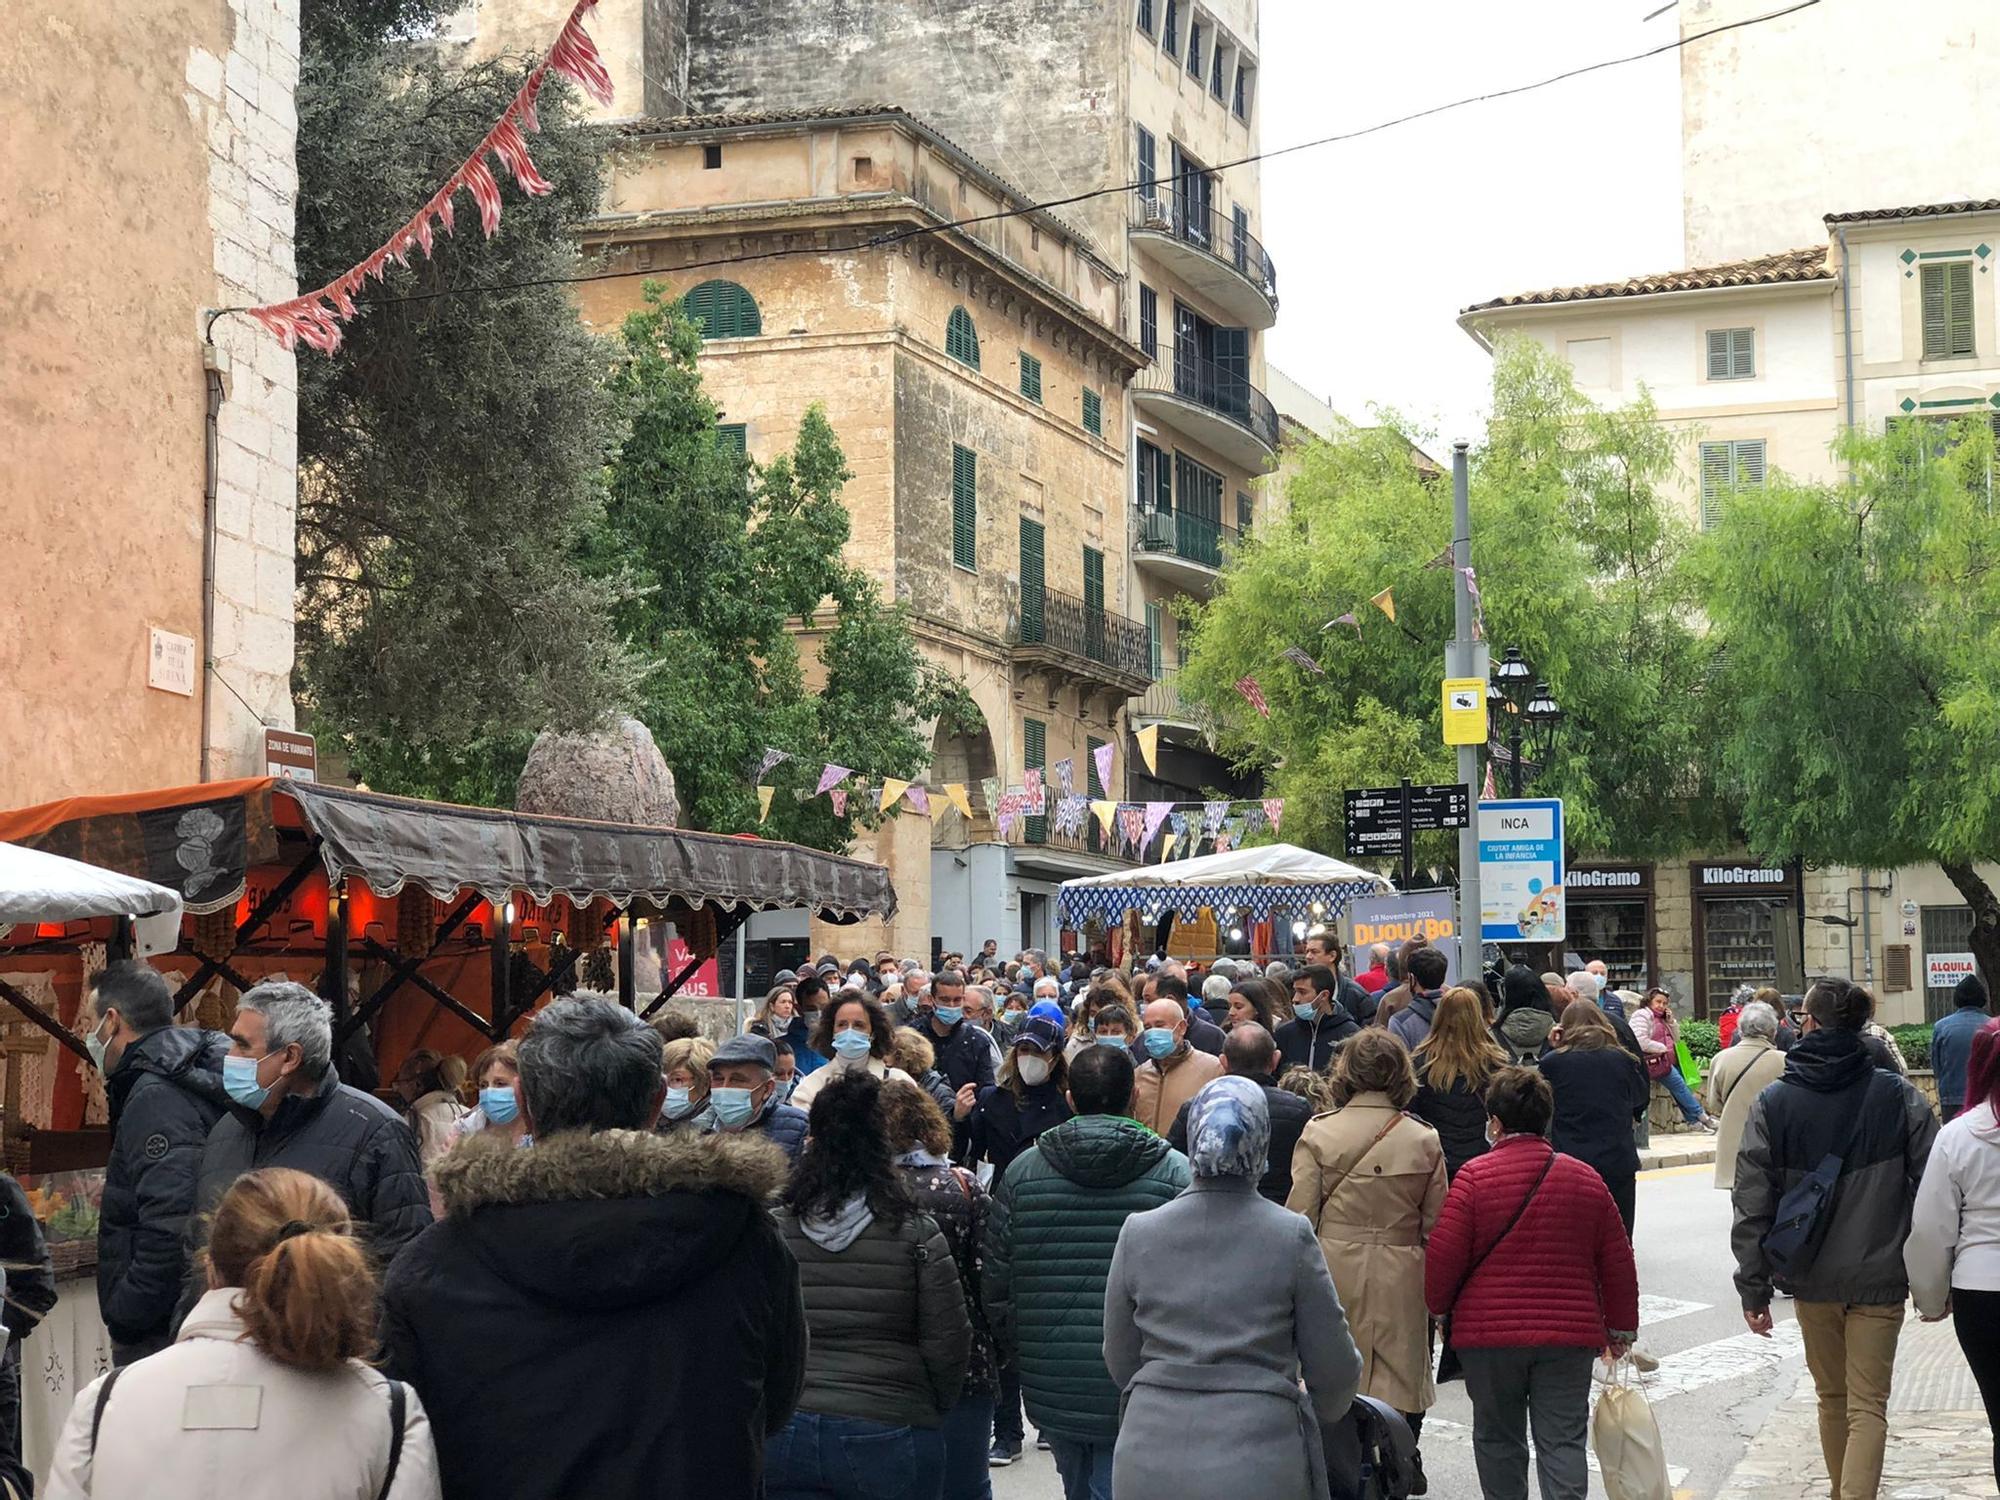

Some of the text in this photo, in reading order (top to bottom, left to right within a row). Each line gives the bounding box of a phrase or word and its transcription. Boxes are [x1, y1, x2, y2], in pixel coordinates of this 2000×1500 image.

[282, 742, 289, 752] DE
[1501, 818, 1529, 829] INCA
[1487, 844, 1510, 852] CIUTAT
[1535, 843, 1544, 851] DE
[1565, 870, 1640, 887] KiloGramo
[1704, 867, 1784, 884] KiloGramo
[1370, 910, 1435, 922] 18 Novembre 2021
[1930, 962, 1973, 972] ALQUILA
